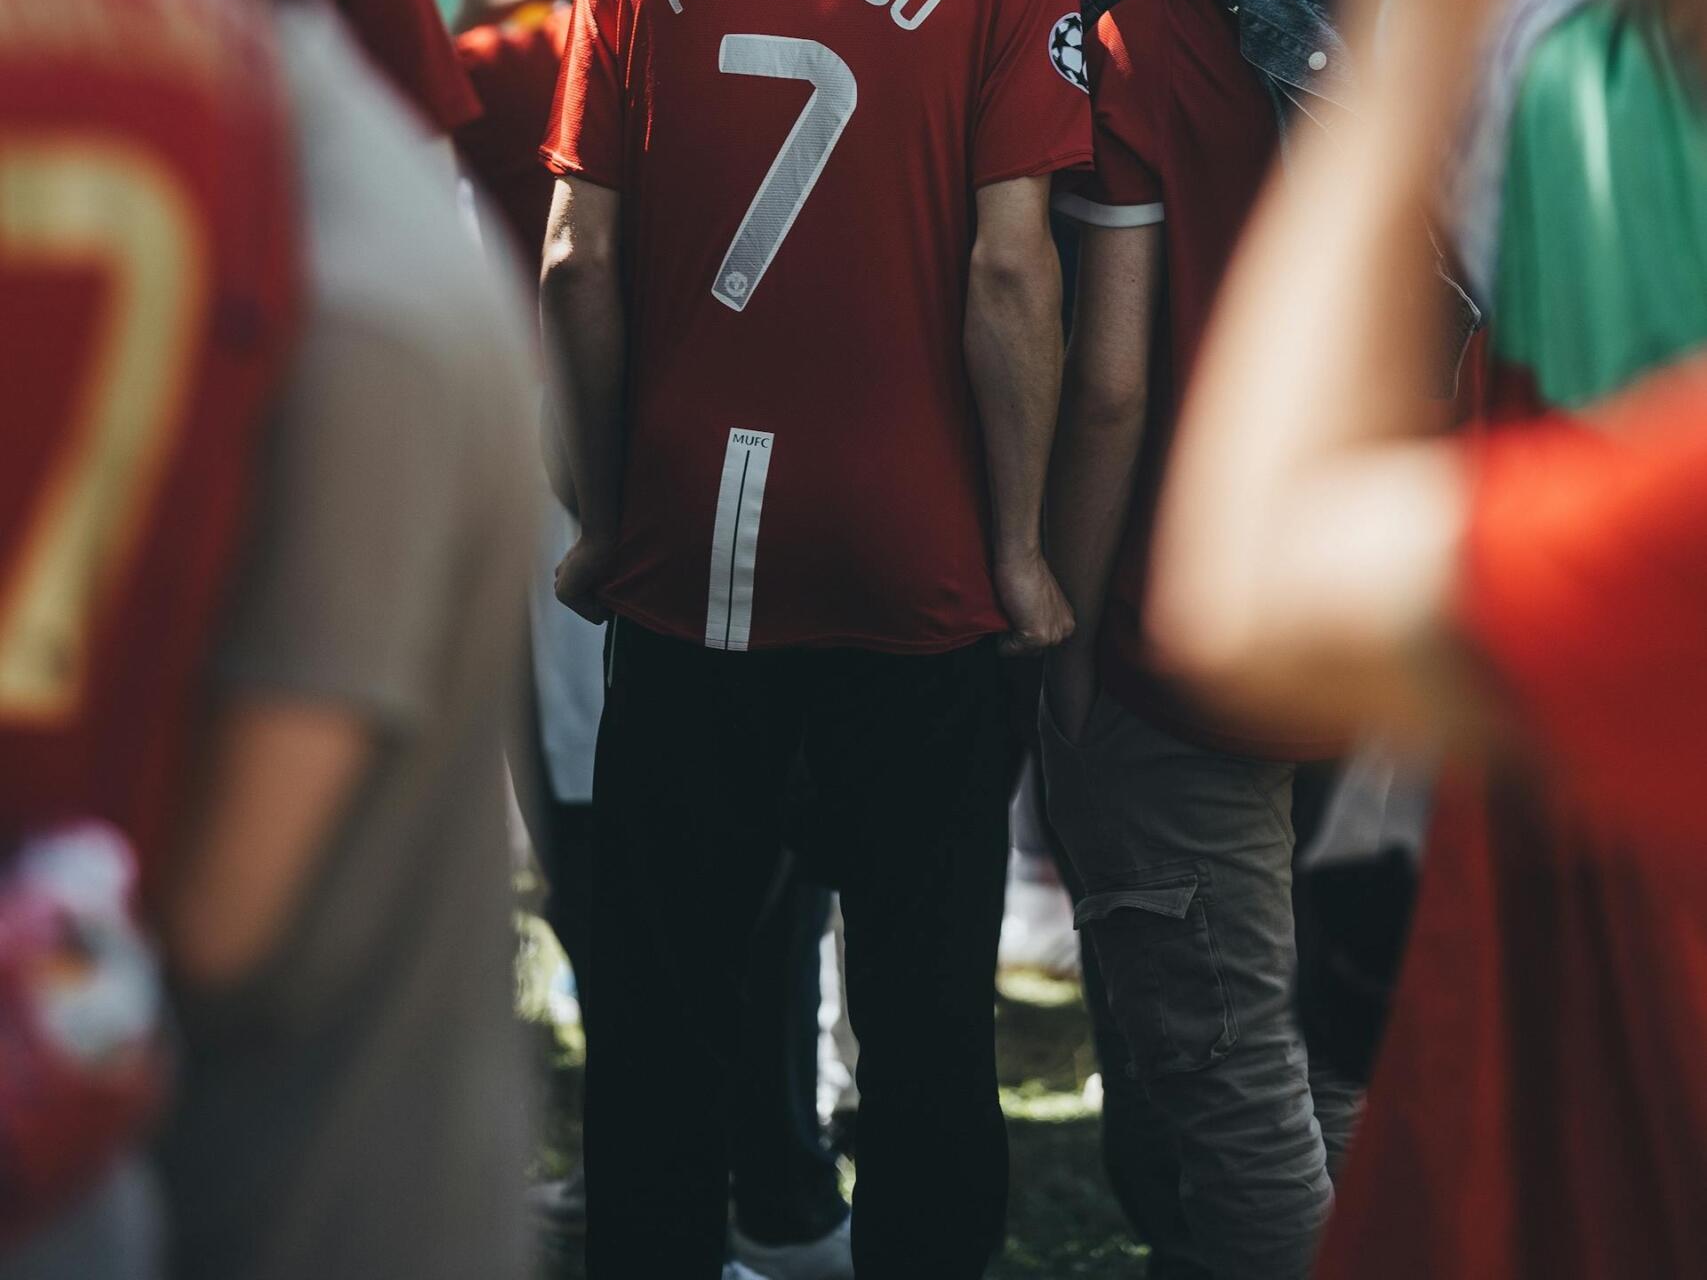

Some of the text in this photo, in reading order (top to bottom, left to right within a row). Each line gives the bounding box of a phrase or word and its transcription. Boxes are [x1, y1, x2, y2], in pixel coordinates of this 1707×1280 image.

[711, 34, 857, 312] 7
[0, 142, 202, 717] 7
[732, 433, 770, 449] MUFC
